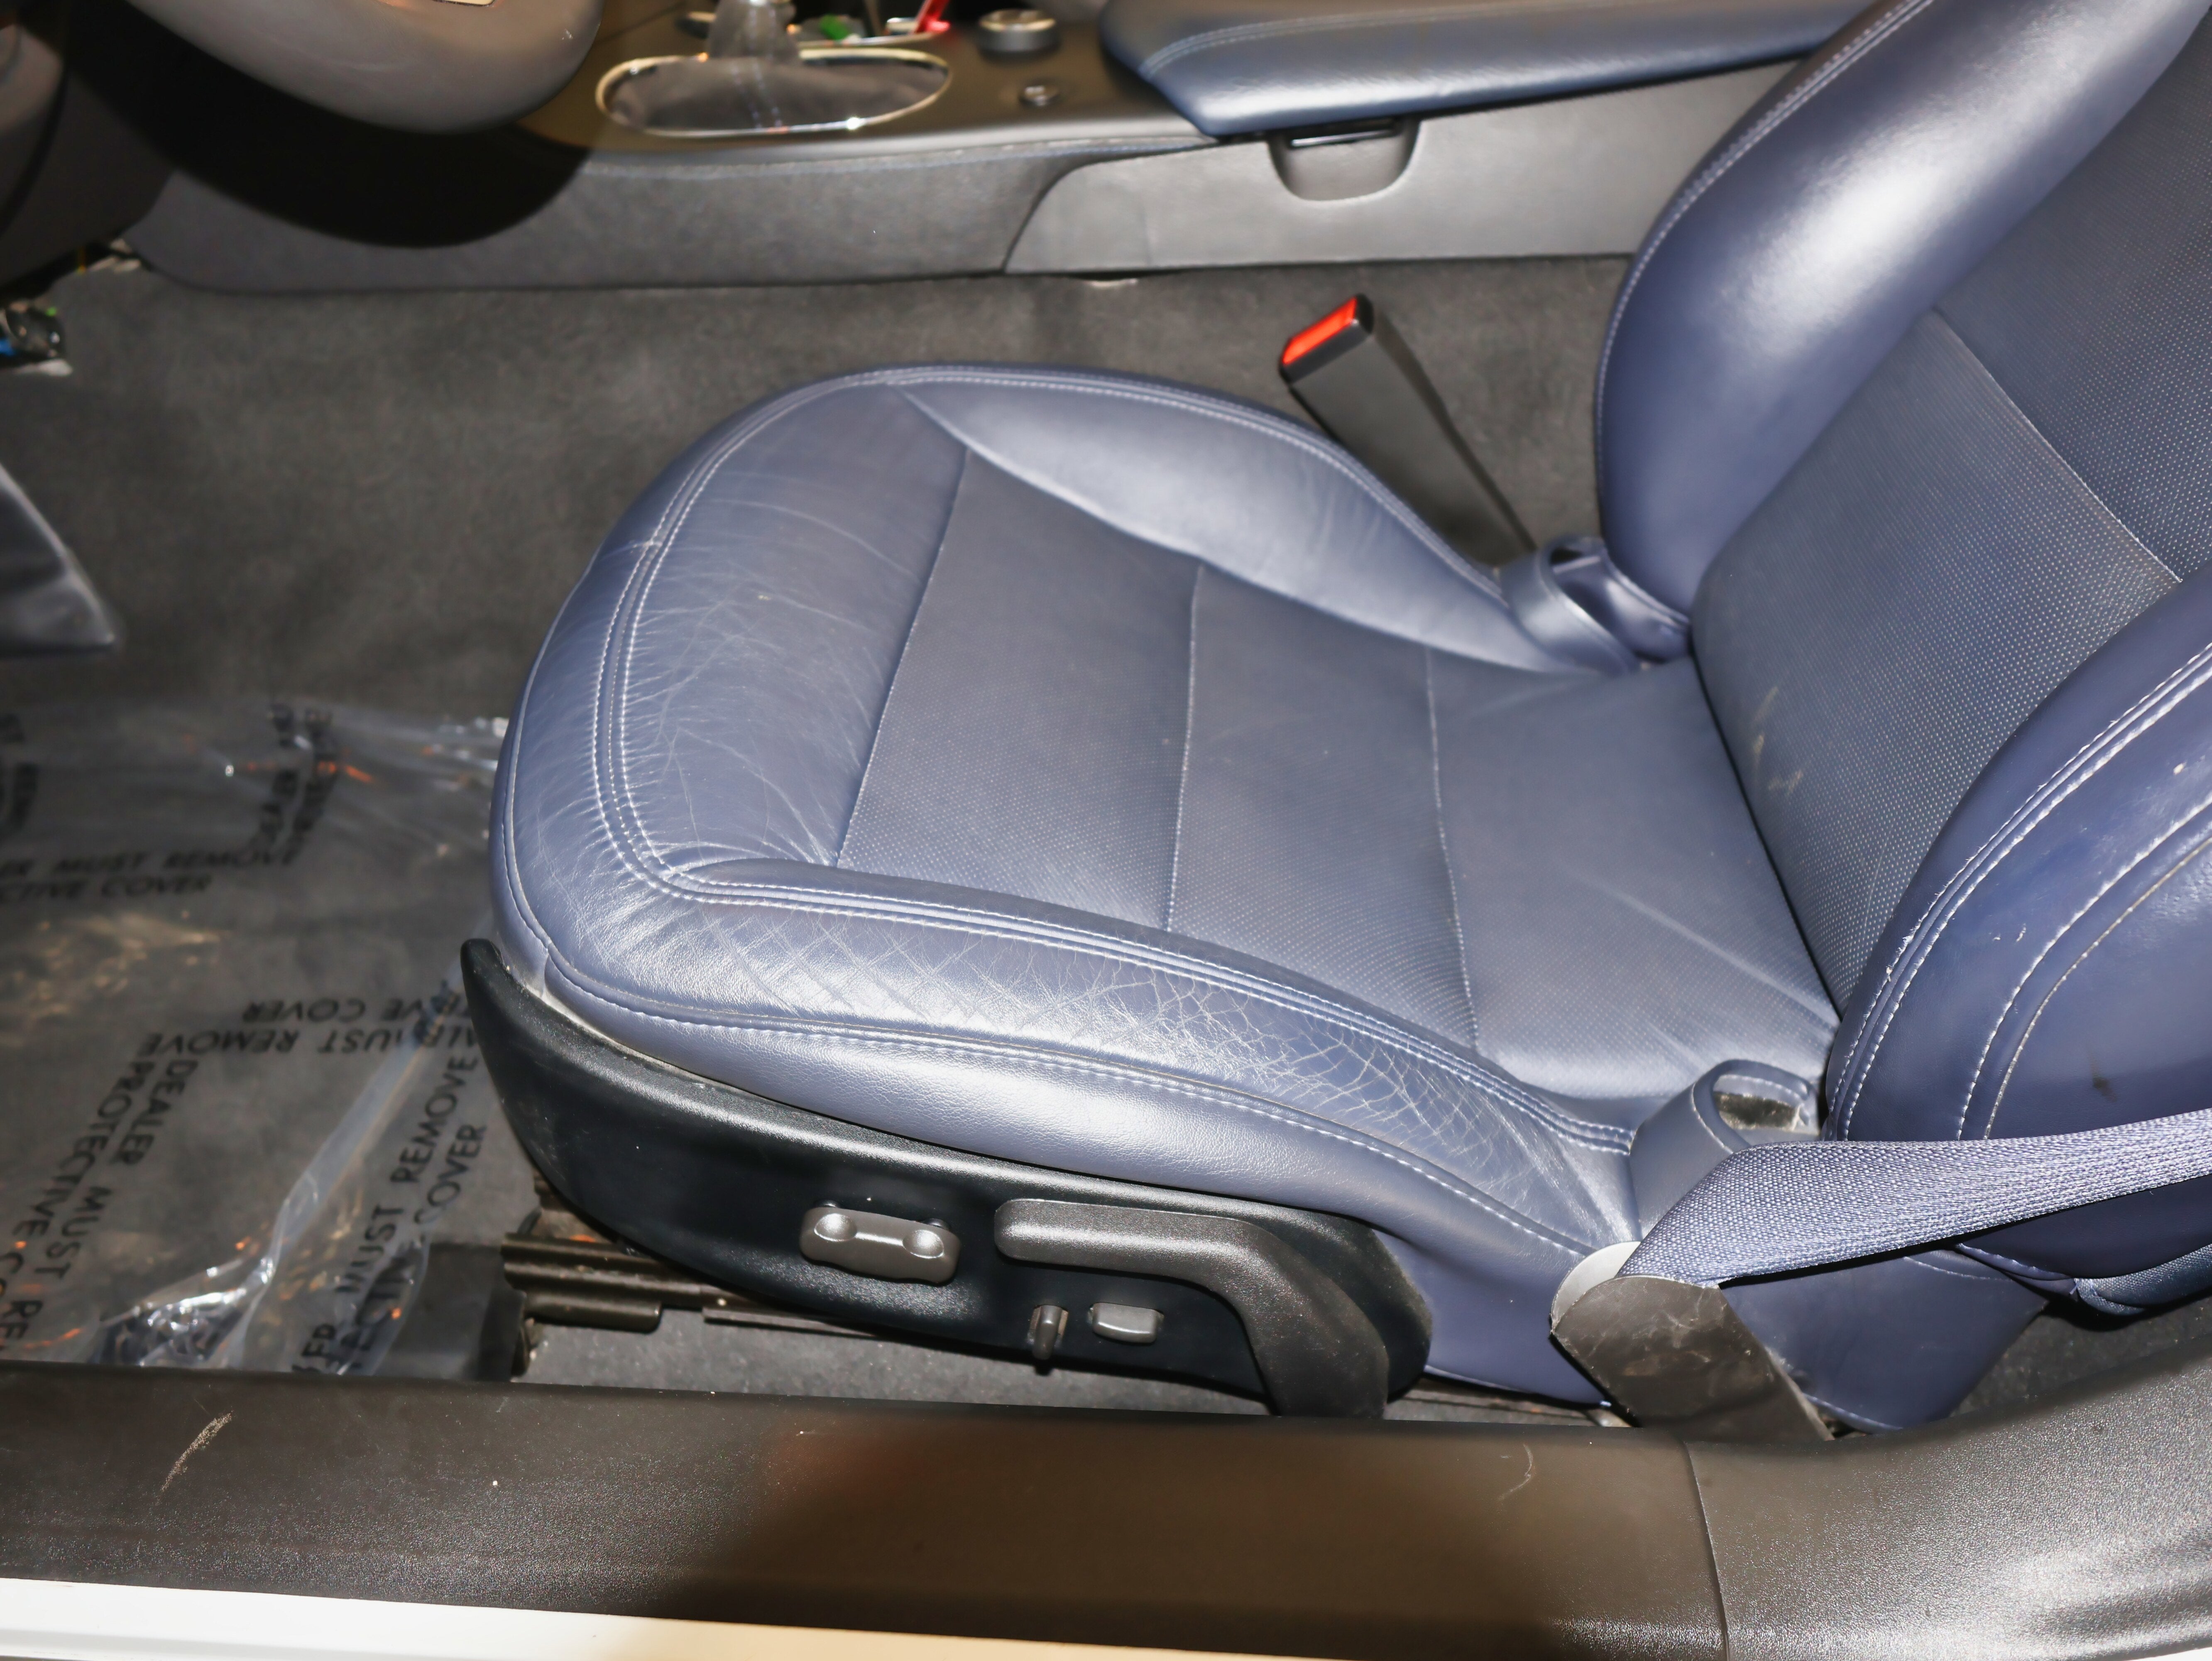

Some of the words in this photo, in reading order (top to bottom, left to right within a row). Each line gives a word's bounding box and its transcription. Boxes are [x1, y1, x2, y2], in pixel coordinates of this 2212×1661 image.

[137, 1030, 300, 1057] REMOVE
[242, 997, 366, 1023] COVER
[12, 1061, 155, 1237] PROTECTIVE
[109, 1060, 199, 1166] DEALER
[389, 1056, 479, 1183] REMOVE
[413, 1124, 487, 1225] COVER
[34, 1186, 113, 1279] MUST
